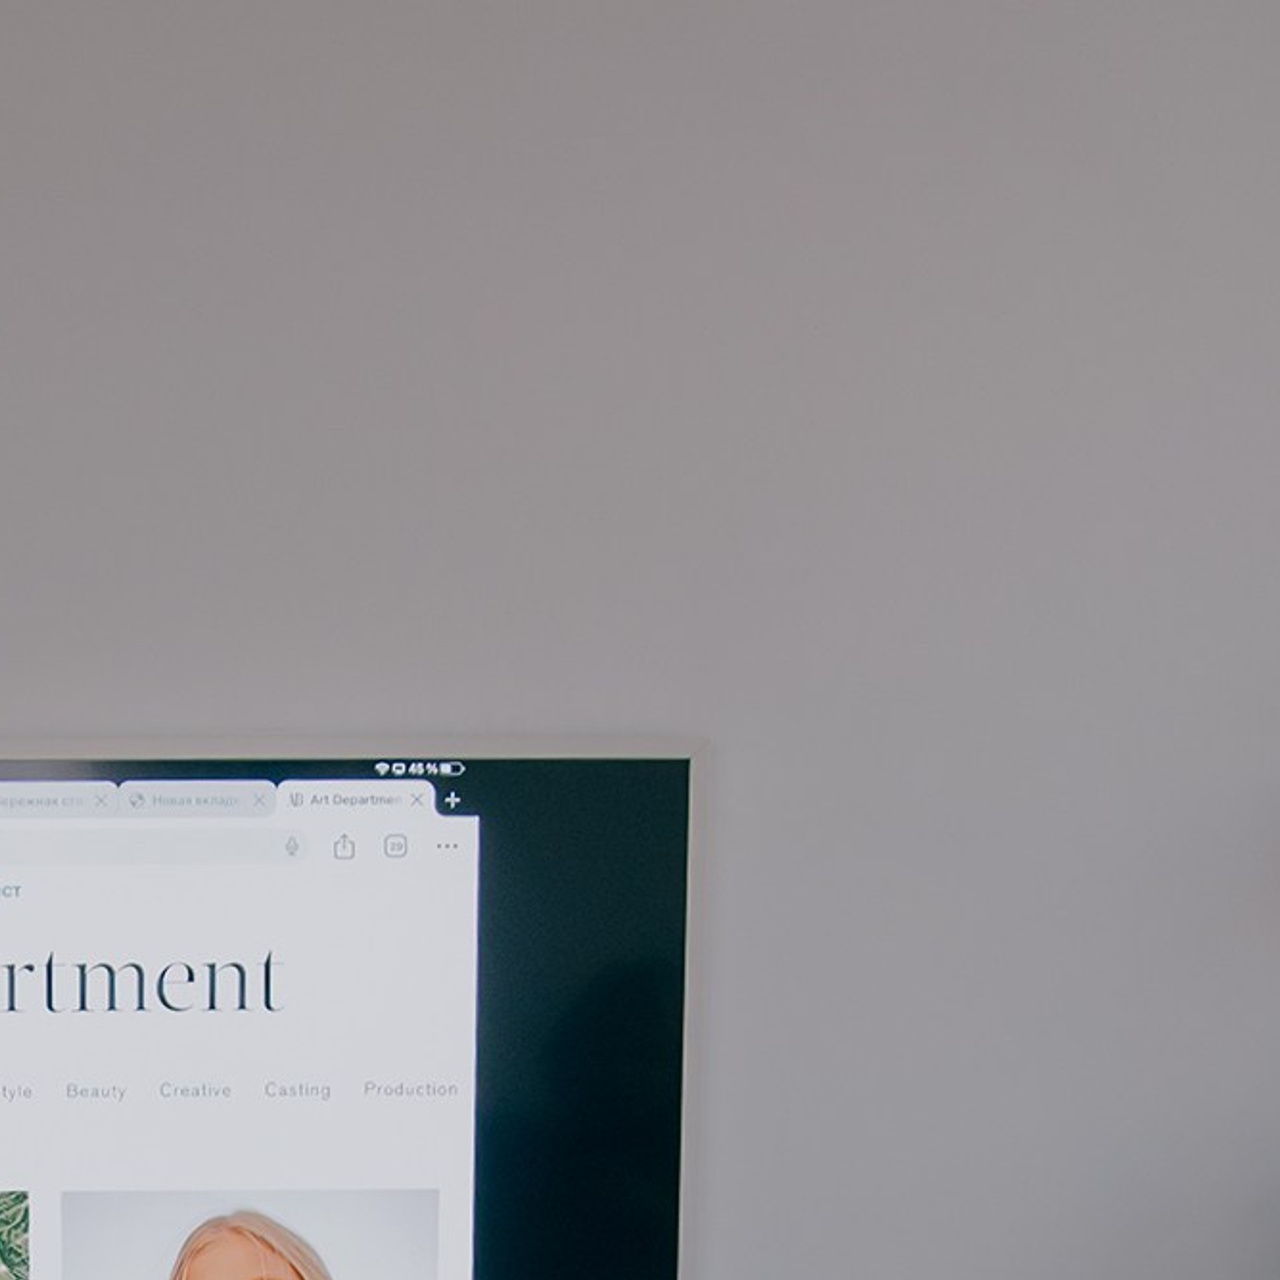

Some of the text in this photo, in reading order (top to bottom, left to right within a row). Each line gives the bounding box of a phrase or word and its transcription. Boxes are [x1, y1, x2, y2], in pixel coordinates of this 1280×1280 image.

[310, 794, 330, 806] Art
[66, 1083, 127, 1102] Beauty
[159, 1081, 232, 1098] Creative
[264, 1080, 331, 1100] Casting
[364, 1080, 459, 1098] Production
